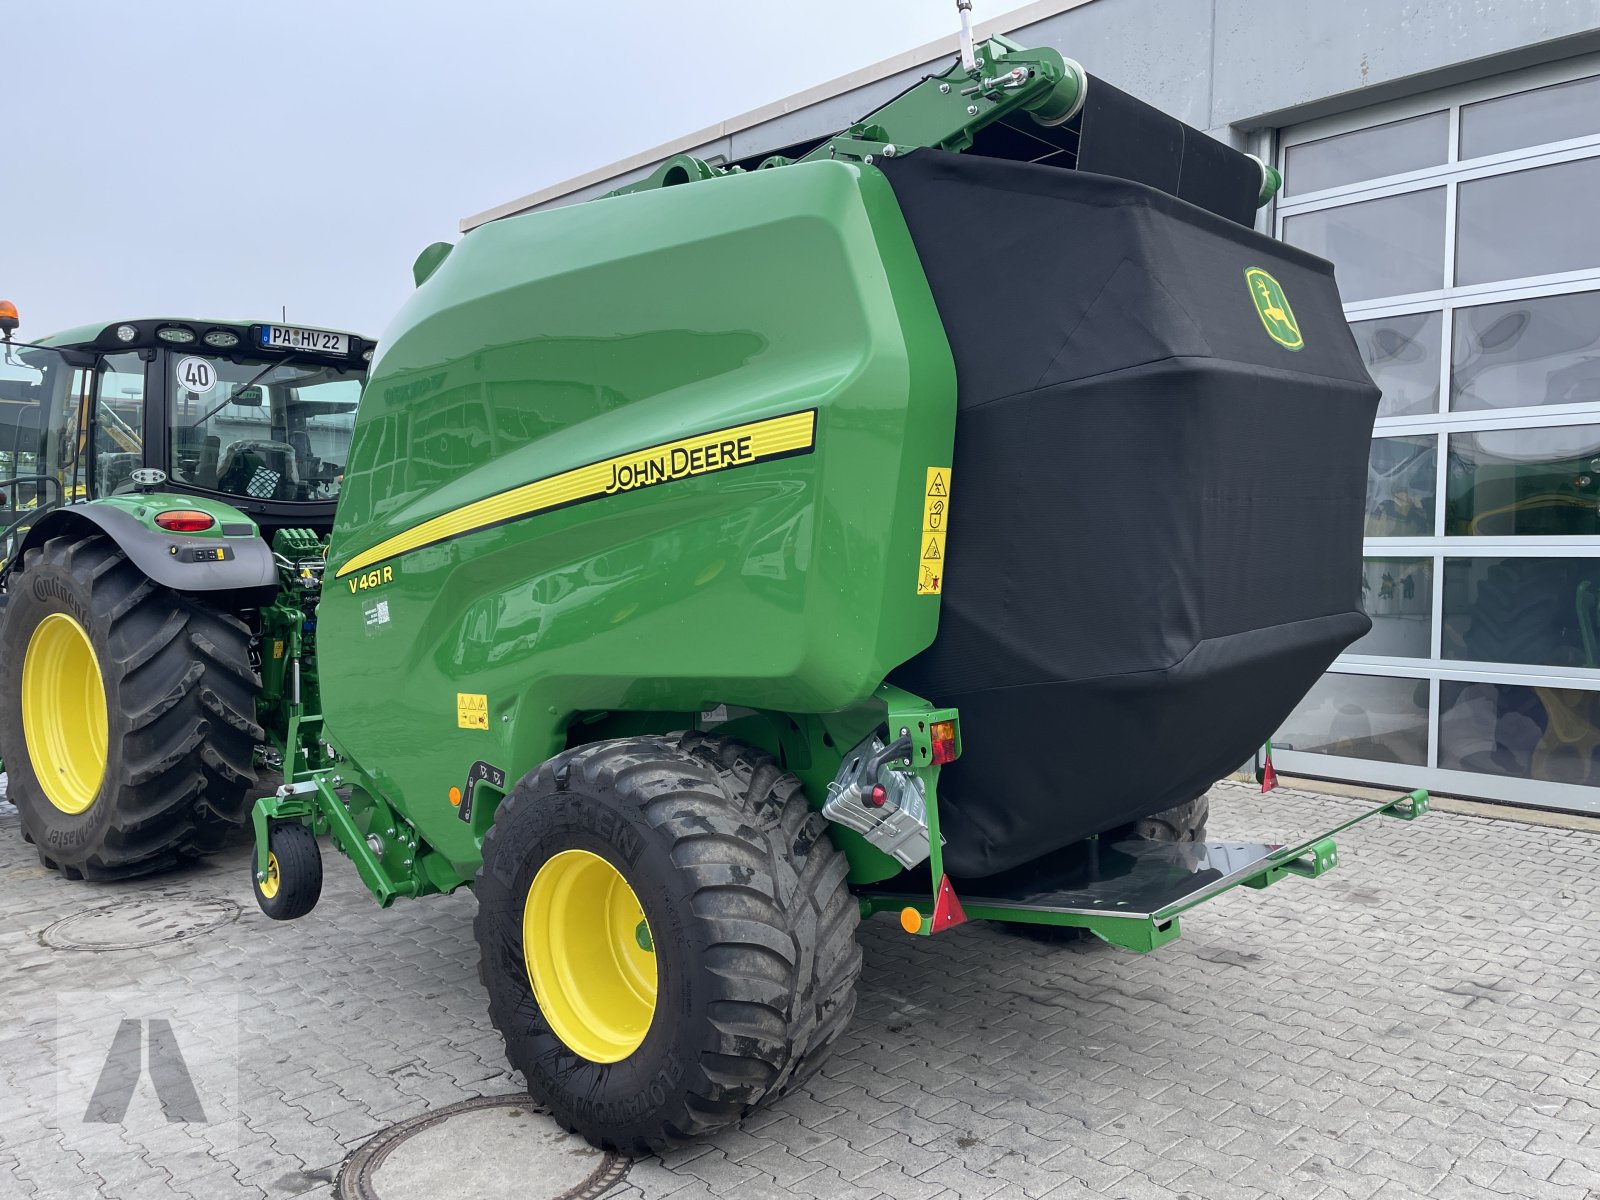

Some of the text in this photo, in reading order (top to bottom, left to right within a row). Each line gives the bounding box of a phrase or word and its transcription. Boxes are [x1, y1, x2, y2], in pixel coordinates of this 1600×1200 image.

[272, 328, 340, 350] PA HV 22
[185, 363, 209, 387] 40
[605, 435, 753, 491] JOHN DEERE
[348, 565, 393, 594] V 461 R
